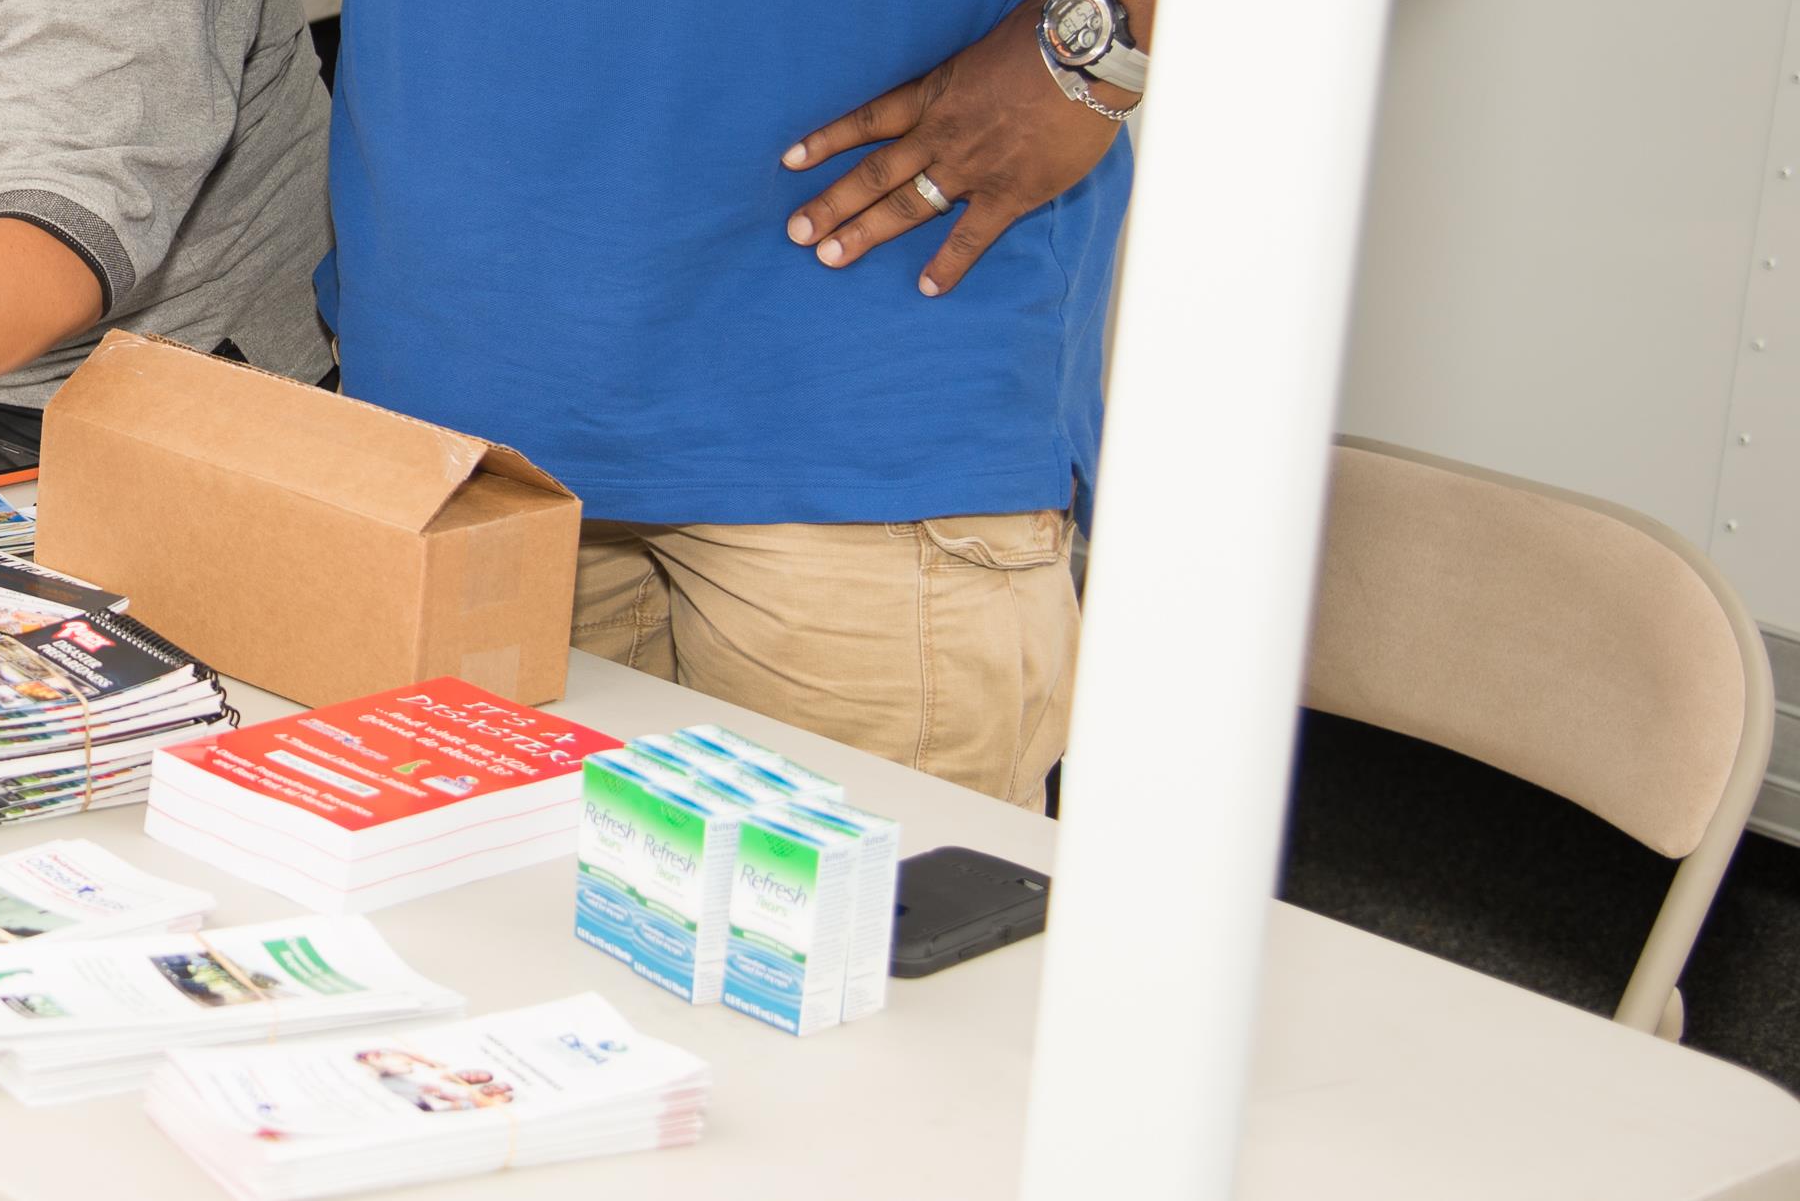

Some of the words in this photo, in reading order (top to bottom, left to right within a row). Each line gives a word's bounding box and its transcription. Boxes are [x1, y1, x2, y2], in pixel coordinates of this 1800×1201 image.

[37, 643, 114, 689] PREPAREDNESS
[51, 639, 104, 670] DISASTER
[357, 713, 418, 739] gonna
[415, 735, 440, 748] do
[438, 745, 489, 767] about
[396, 693, 586, 766] DISASTER!
[423, 725, 468, 746] what
[465, 742, 496, 757] are
[462, 701, 537, 728] IT'S
[539, 731, 576, 744] A
[583, 800, 637, 844] Refresh
[642, 832, 697, 879] Refresh
[738, 862, 808, 908] Refresh
[755, 895, 788, 918] Tears
